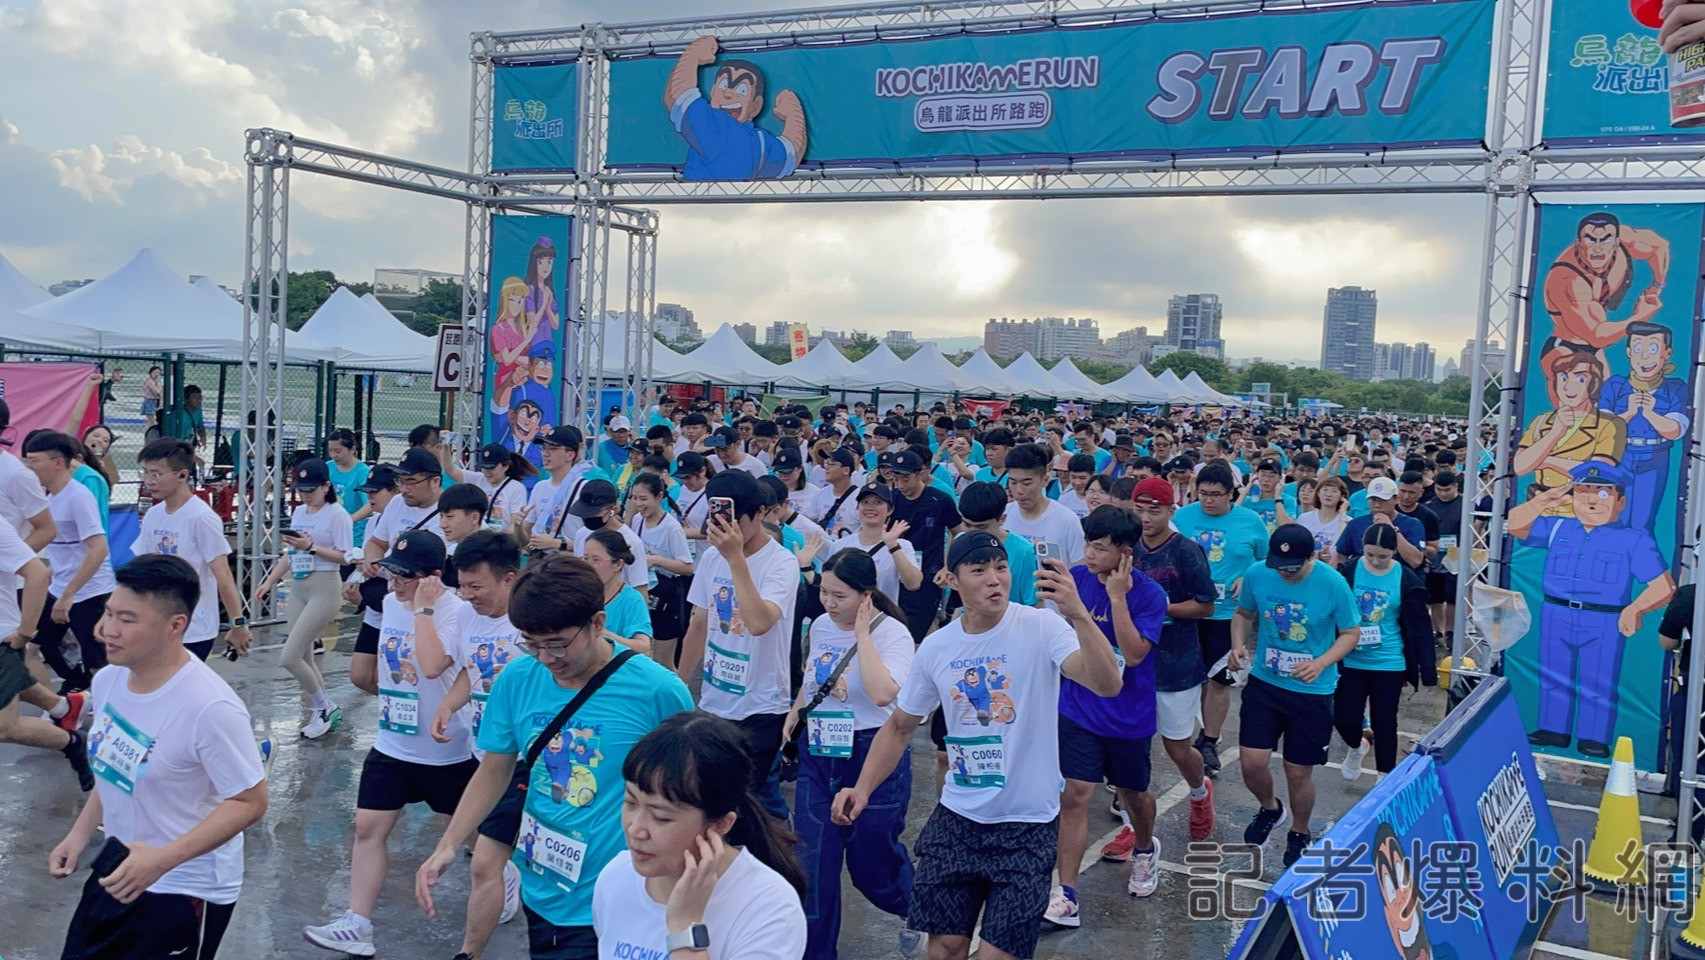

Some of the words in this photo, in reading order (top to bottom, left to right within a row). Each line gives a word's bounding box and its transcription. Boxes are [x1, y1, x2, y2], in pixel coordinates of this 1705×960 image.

[1147, 37, 1445, 122] START
[1592, 66, 1670, 94] 派出
[919, 101, 1046, 124] 烏龍派出所路跑
[514, 119, 564, 139] 派出所
[720, 660, 745, 674] C0201
[395, 702, 416, 712] C1034
[827, 723, 853, 733] C0202
[112, 737, 140, 764] A0381
[972, 749, 1003, 761] C0060
[545, 837, 581, 862] C0206
